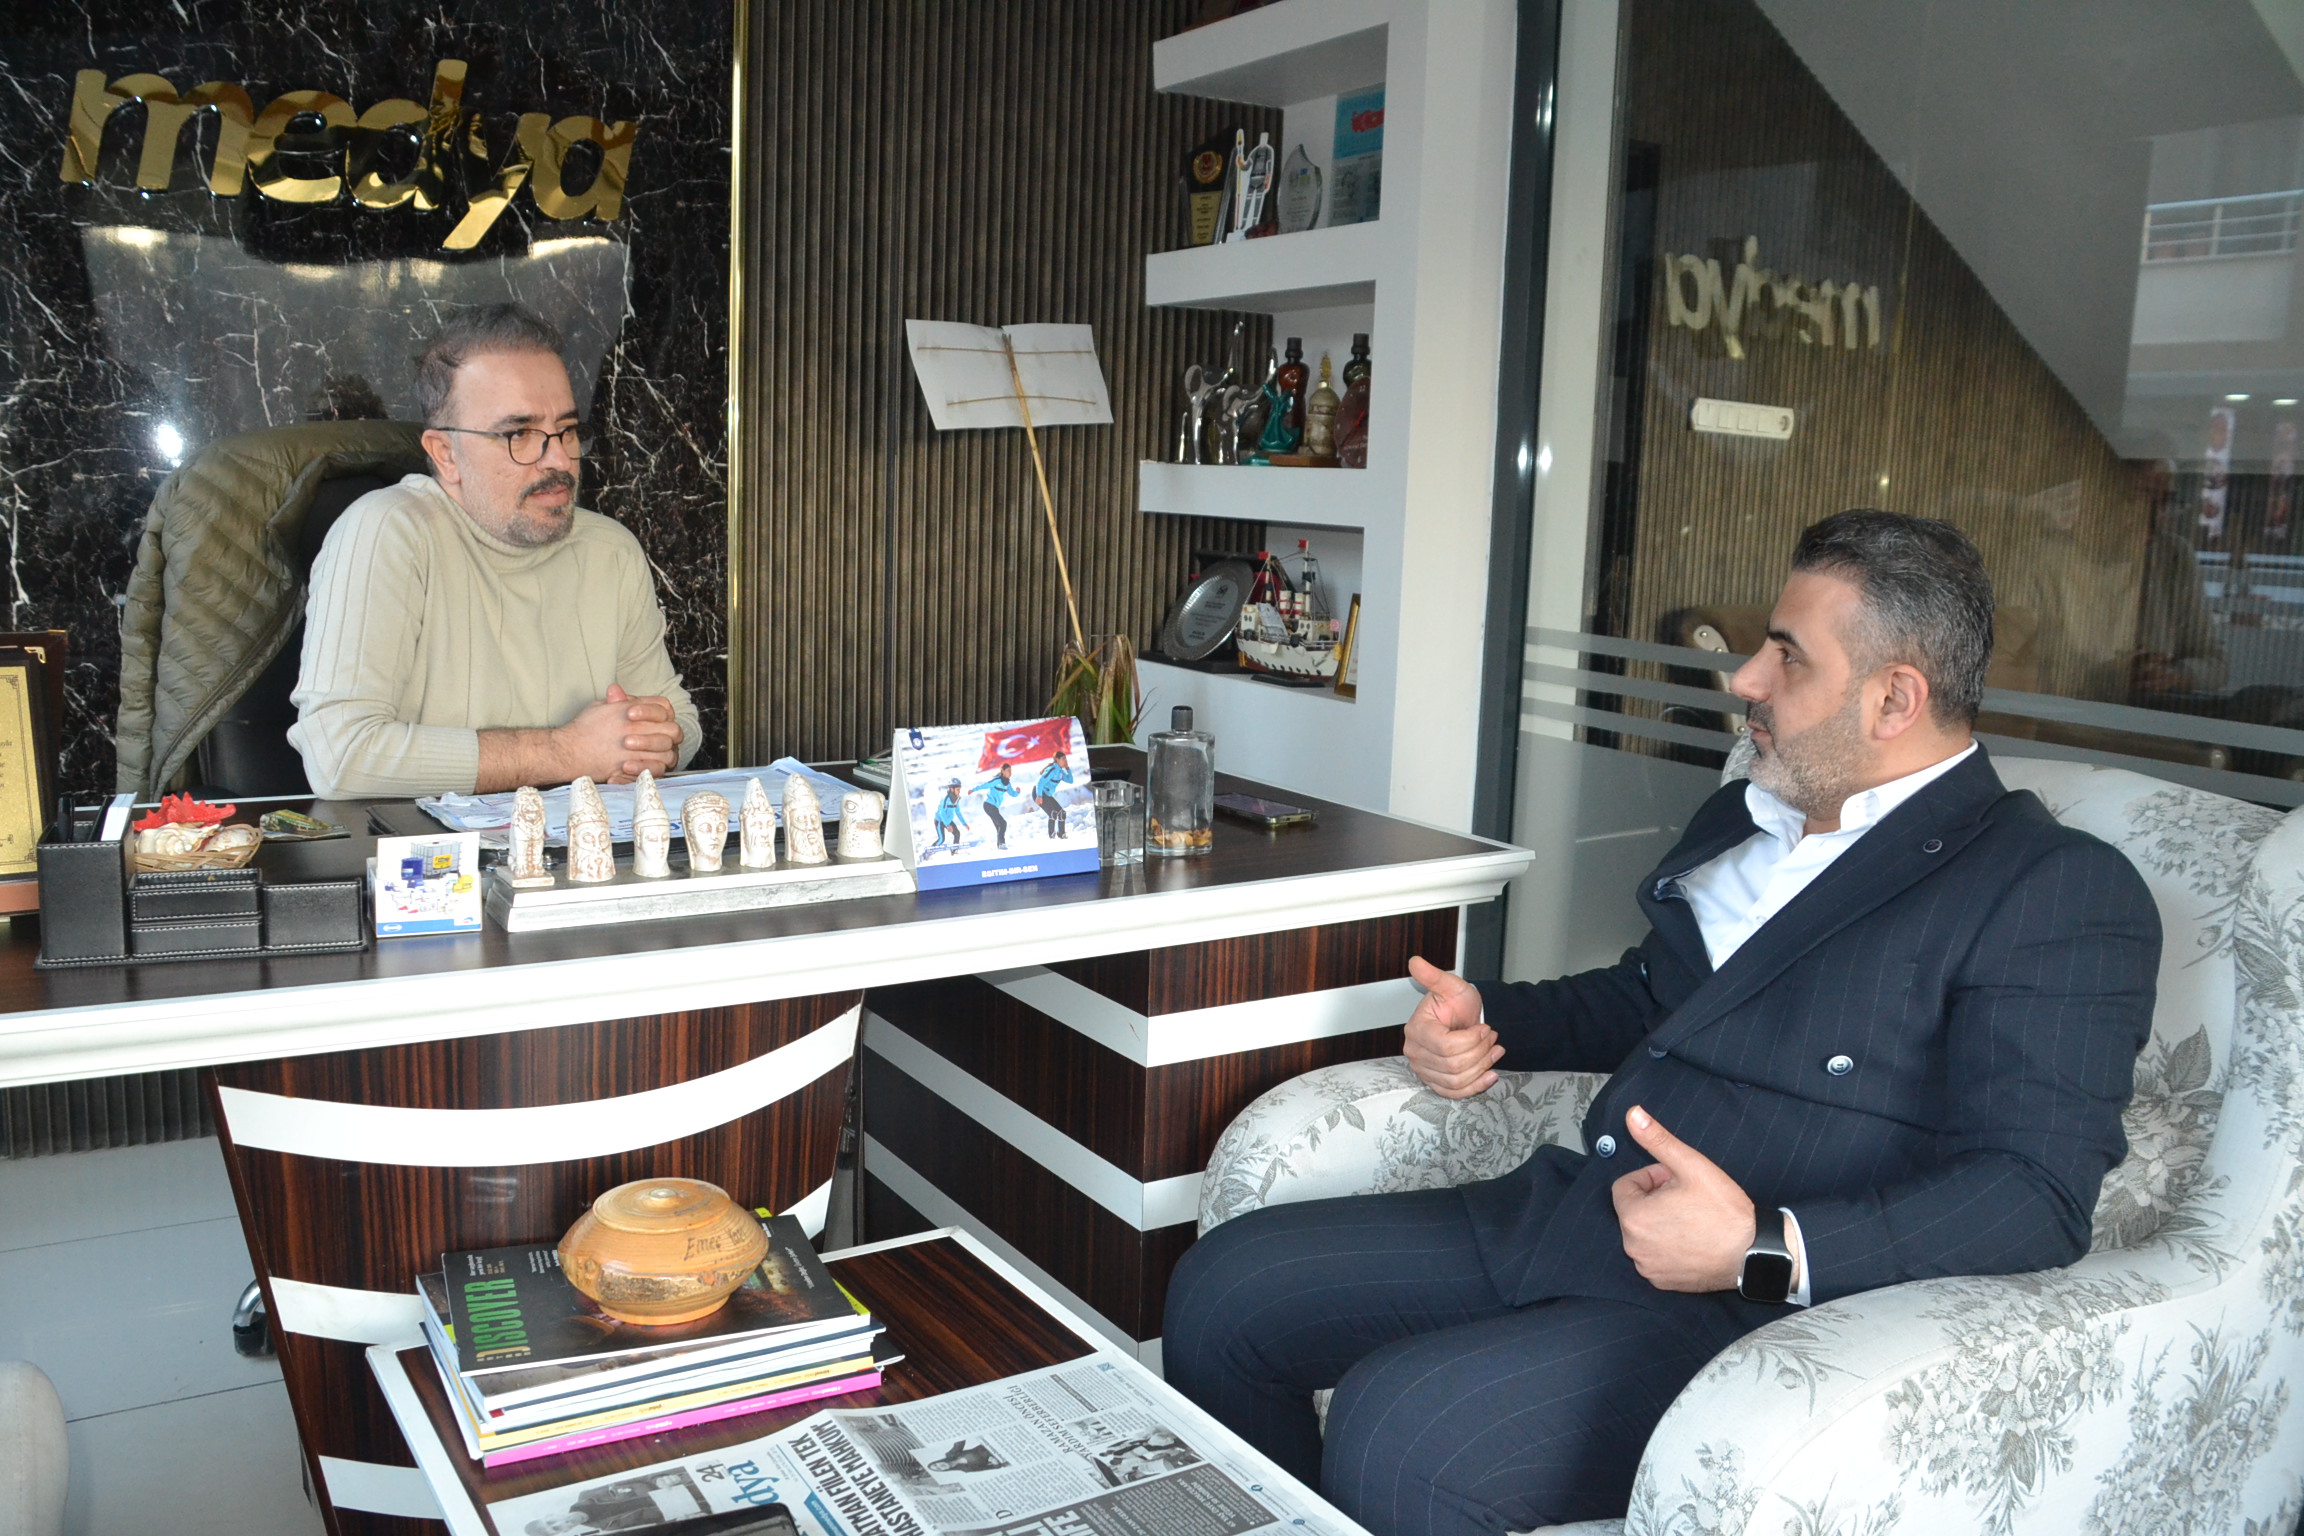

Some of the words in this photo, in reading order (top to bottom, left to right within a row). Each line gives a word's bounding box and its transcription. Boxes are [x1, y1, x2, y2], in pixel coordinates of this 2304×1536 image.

[59, 59, 638, 250] medya
[788, 1432, 822, 1462] TEK
[1031, 1418, 1074, 1454] RAMAZAN
